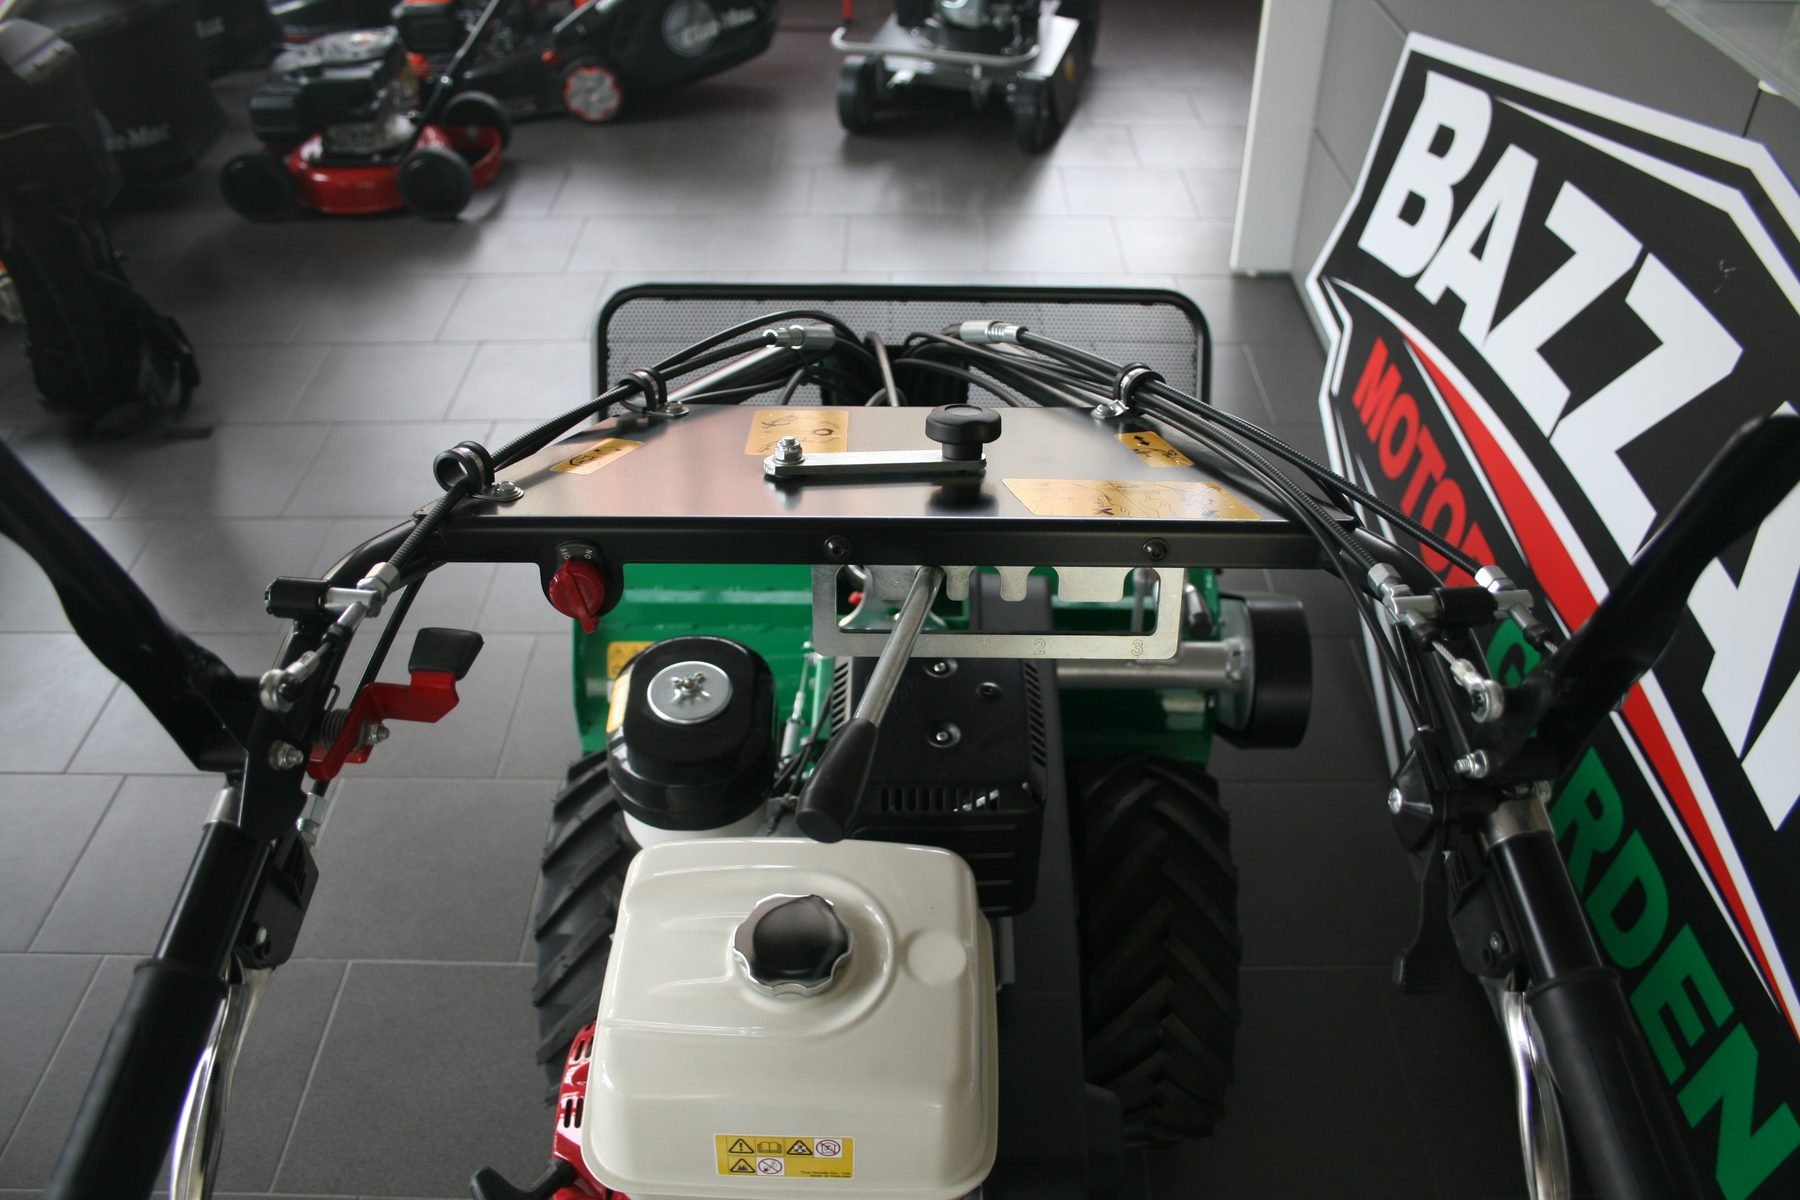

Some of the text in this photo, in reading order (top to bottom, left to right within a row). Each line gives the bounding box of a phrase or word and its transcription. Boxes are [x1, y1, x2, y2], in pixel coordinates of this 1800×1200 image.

[584, 548, 593, 560] ON
[1033, 638, 1047, 656] 2
[1130, 639, 1144, 657] 3
